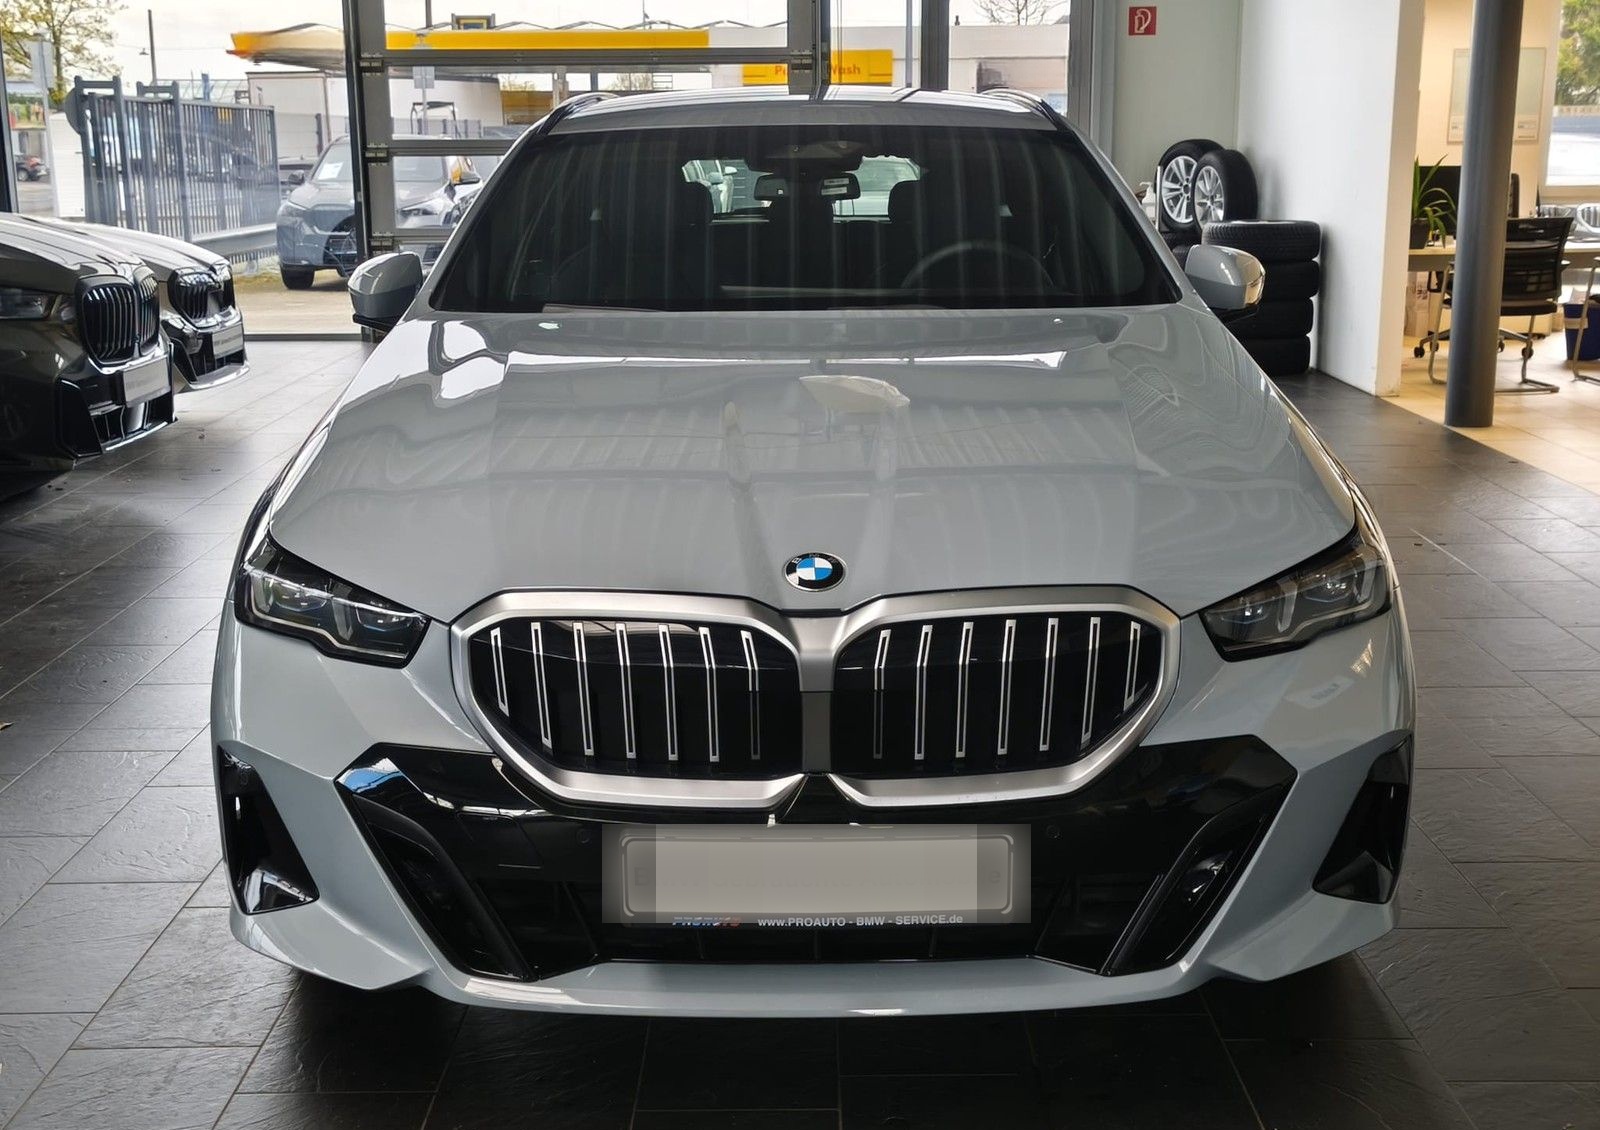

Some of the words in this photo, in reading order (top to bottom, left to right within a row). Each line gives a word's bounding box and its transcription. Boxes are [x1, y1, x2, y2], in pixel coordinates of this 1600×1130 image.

[757, 916, 846, 927] www.PROAUTO
[856, 916, 885, 926] BMW
[895, 914, 963, 925] SERVICE.de
